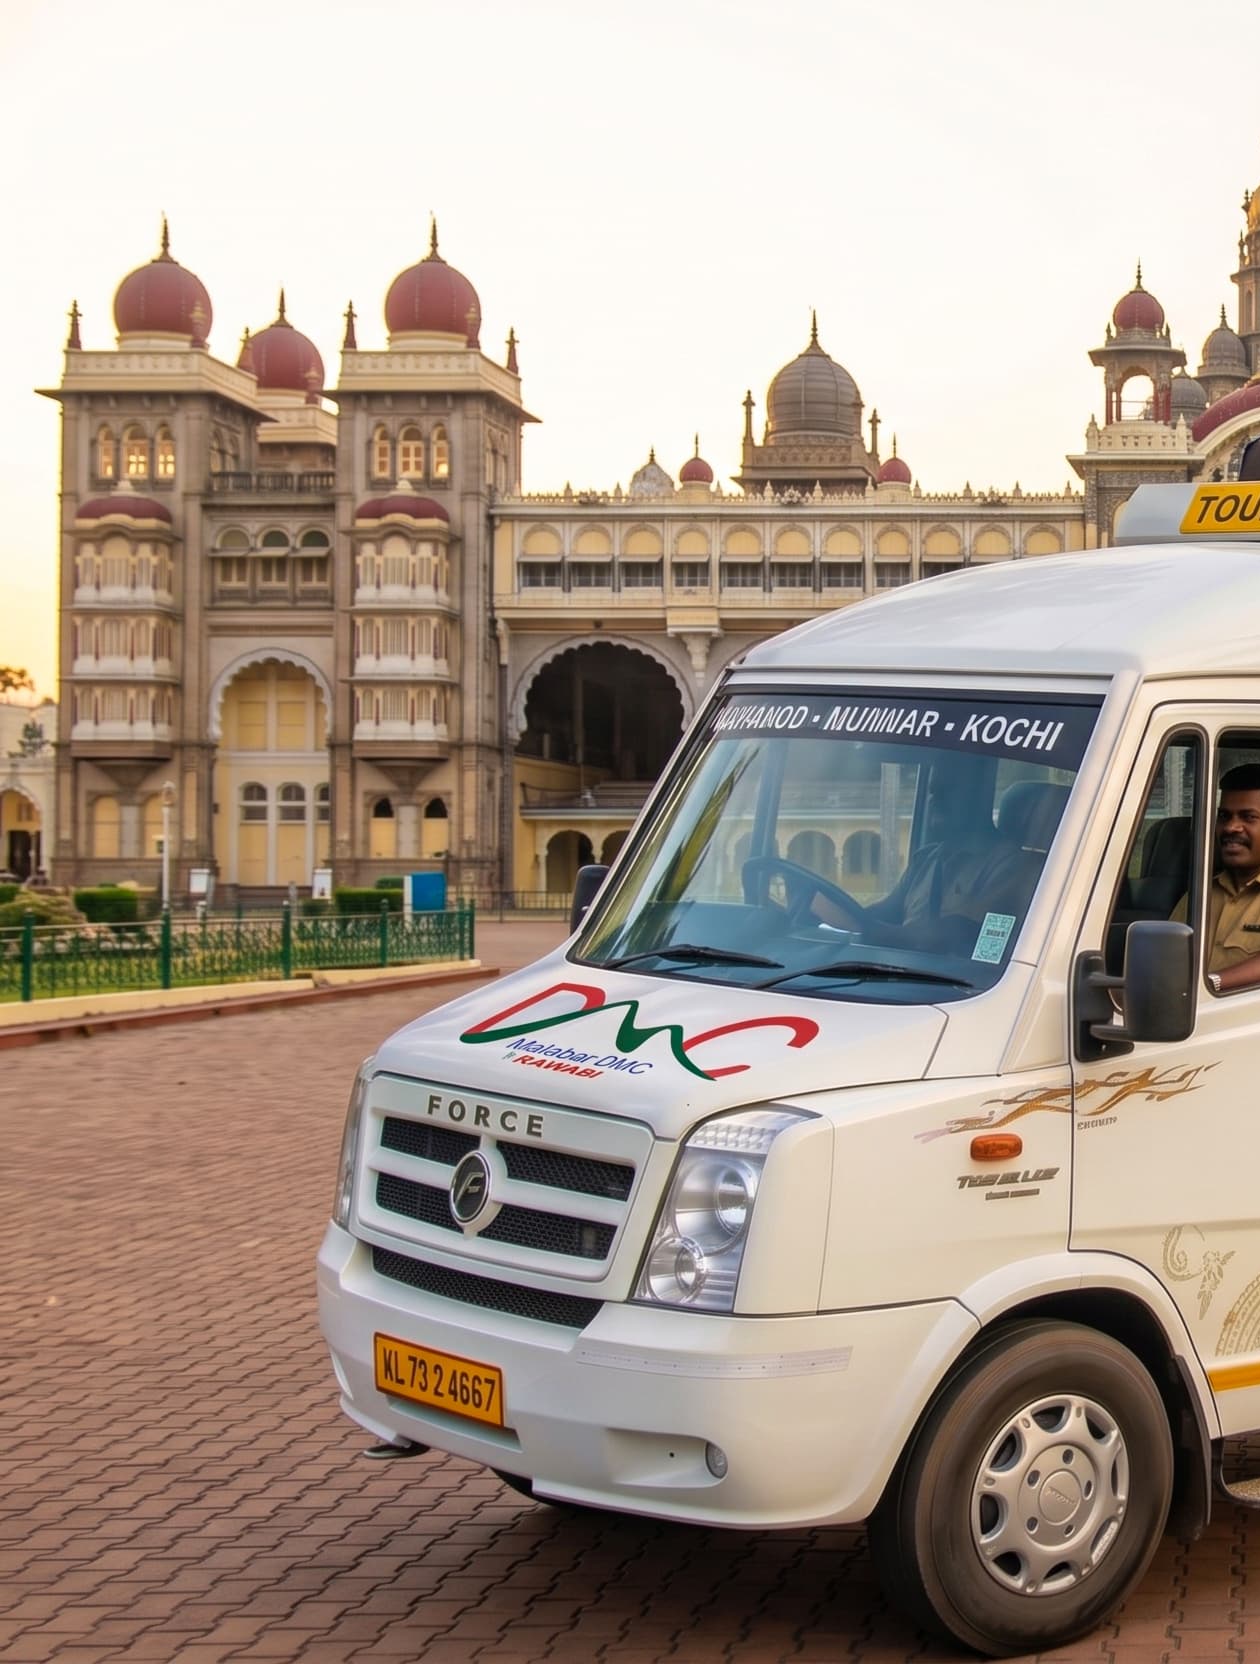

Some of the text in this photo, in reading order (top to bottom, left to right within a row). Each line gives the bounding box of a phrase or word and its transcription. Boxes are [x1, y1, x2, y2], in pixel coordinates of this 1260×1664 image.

[959, 714, 1064, 751] KOCHI
[506, 1038, 653, 1075] Malabar DMC
[512, 1055, 604, 1078] RAWABI
[427, 1094, 544, 1137] FORCE
[383, 1347, 405, 1386] KL
[408, 1355, 428, 1392] 73
